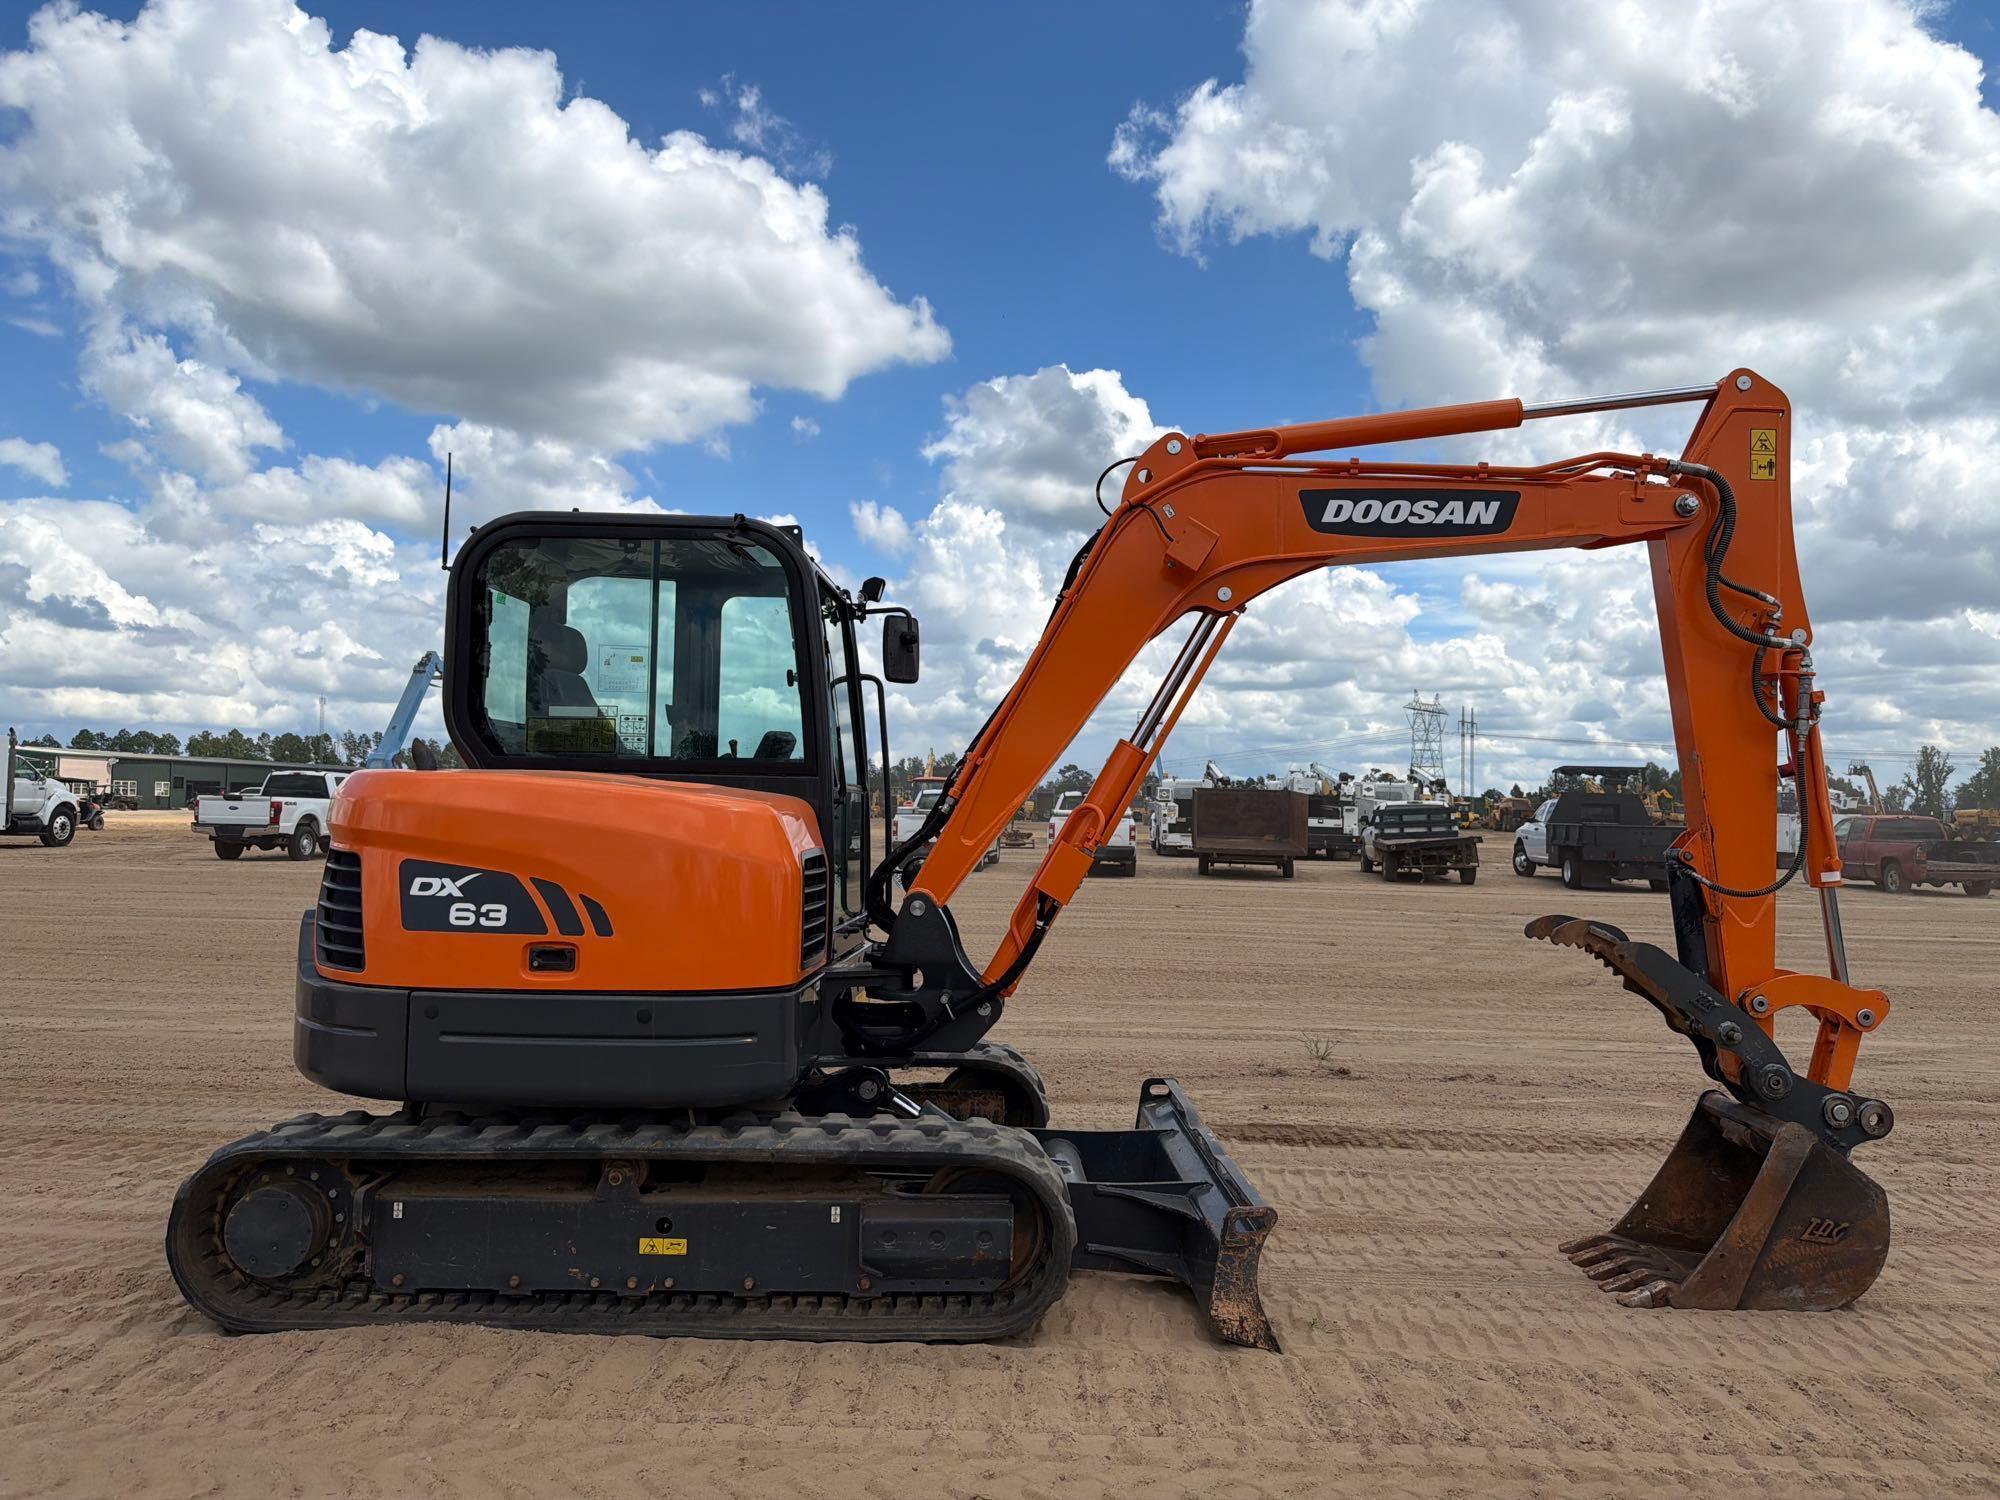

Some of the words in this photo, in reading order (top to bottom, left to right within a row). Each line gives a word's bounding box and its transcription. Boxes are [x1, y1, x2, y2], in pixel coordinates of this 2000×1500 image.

[1321, 499, 1501, 525] DOOSAN
[409, 872, 484, 898] DX
[449, 902, 508, 927] 63
